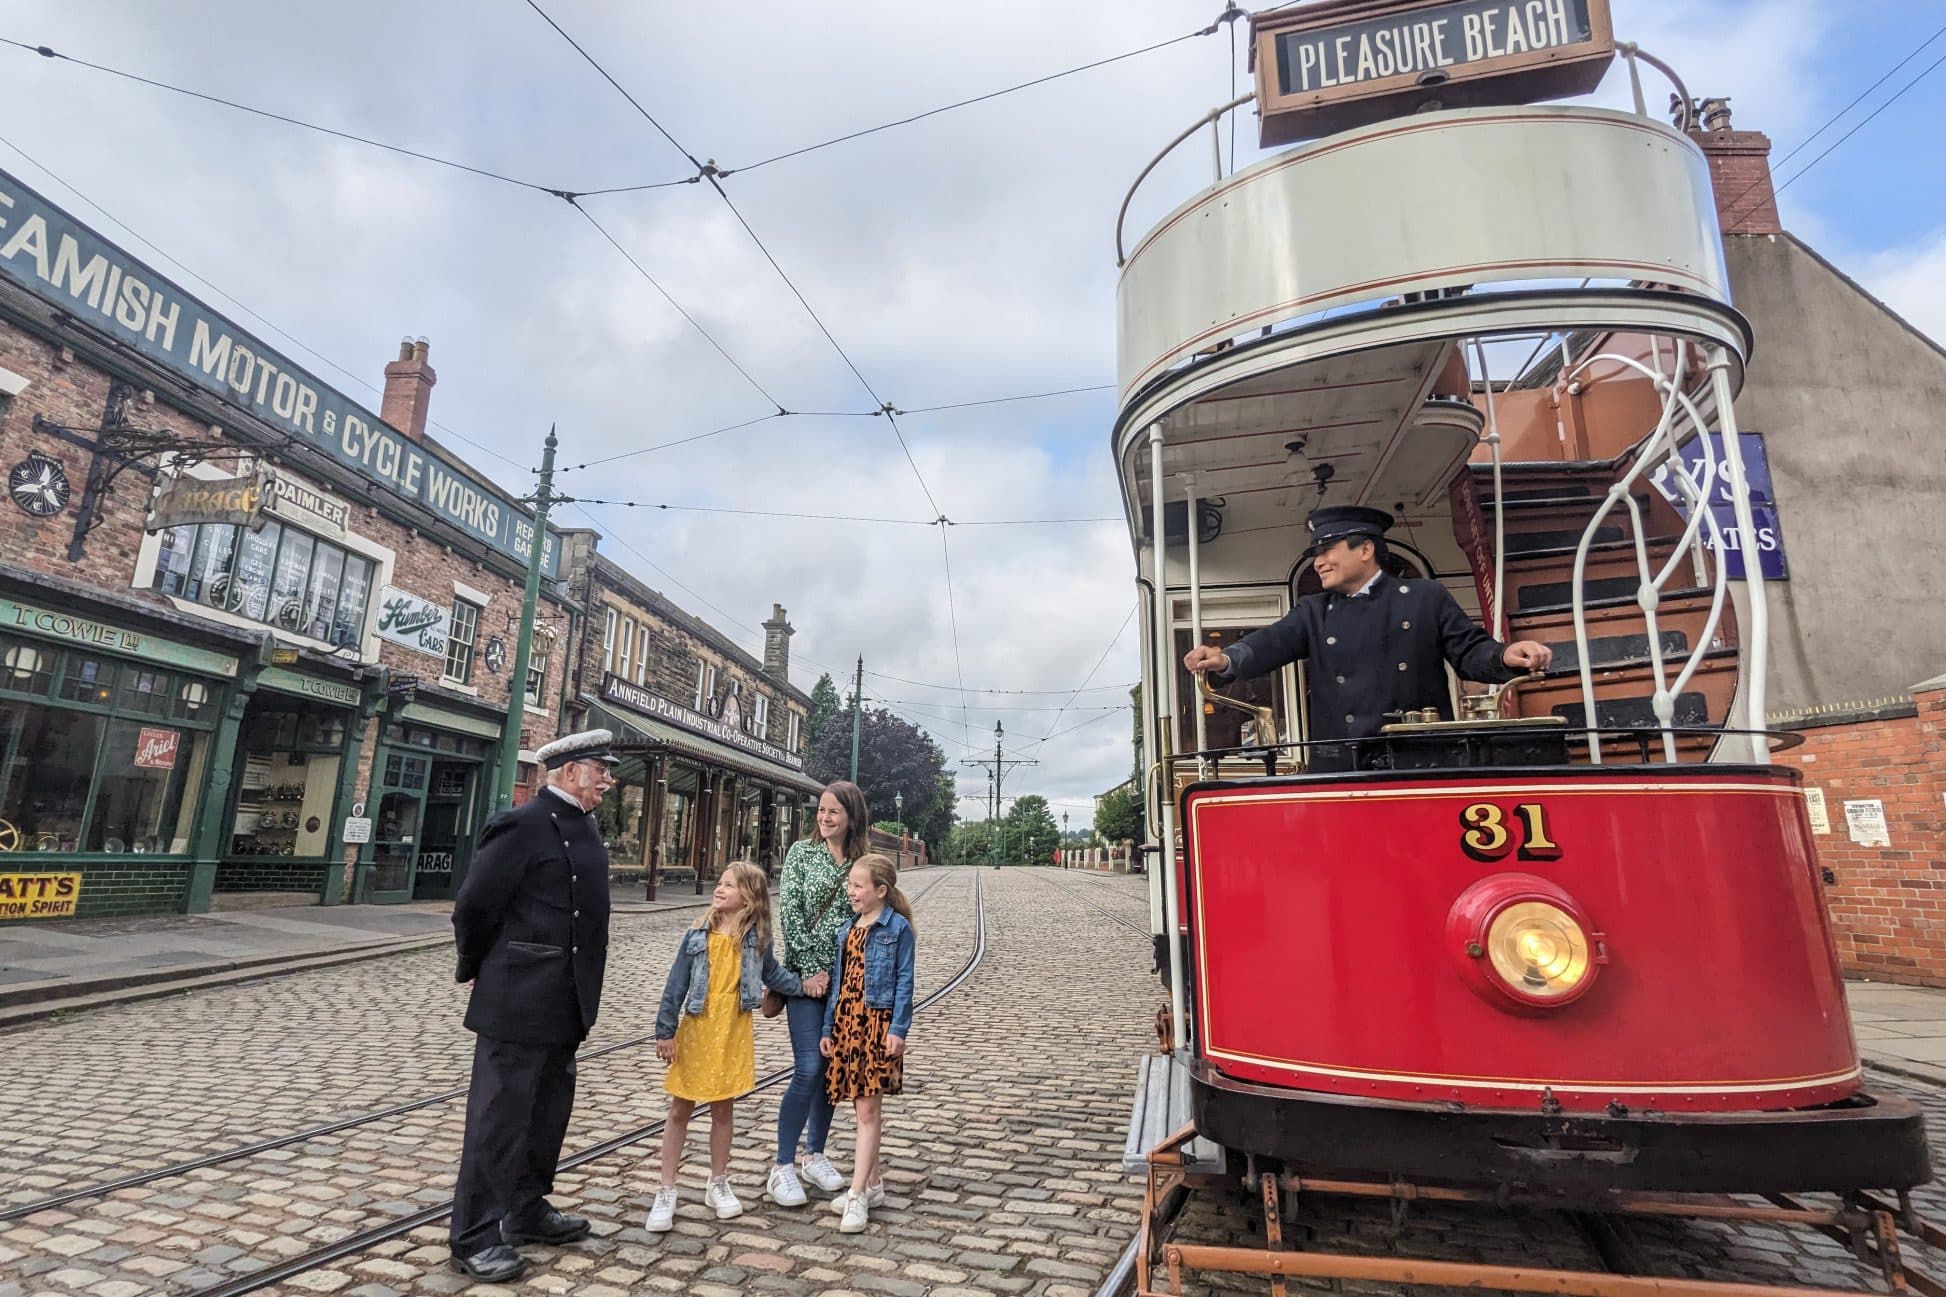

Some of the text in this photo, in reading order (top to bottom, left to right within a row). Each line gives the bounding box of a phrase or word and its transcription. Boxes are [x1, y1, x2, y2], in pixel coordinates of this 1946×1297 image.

[1299, 0, 1569, 91] PLEASURE BEACH
[189, 319, 318, 435] MOTOR
[322, 410, 337, 434] &
[342, 414, 424, 496] CYCLE
[428, 464, 499, 538] WORKS
[274, 478, 343, 525] DAIMLER
[514, 536, 550, 568] GARE
[13, 604, 33, 626] T
[35, 610, 118, 647] COWIE
[378, 597, 443, 634] Humber
[418, 628, 445, 654] CARS
[311, 681, 346, 700] COWIE
[608, 678, 657, 711] ANNFIELD
[657, 698, 683, 721] PLAIN
[682, 708, 722, 738] INDUSTRIAL
[721, 725, 762, 753] CO-OPERATIVE
[762, 742, 781, 760] SOCIETY
[136, 734, 175, 764] Ariel
[1459, 802, 1564, 862] 31
[416, 854, 454, 870] ARAG
[31, 900, 72, 913] SPIRIT
